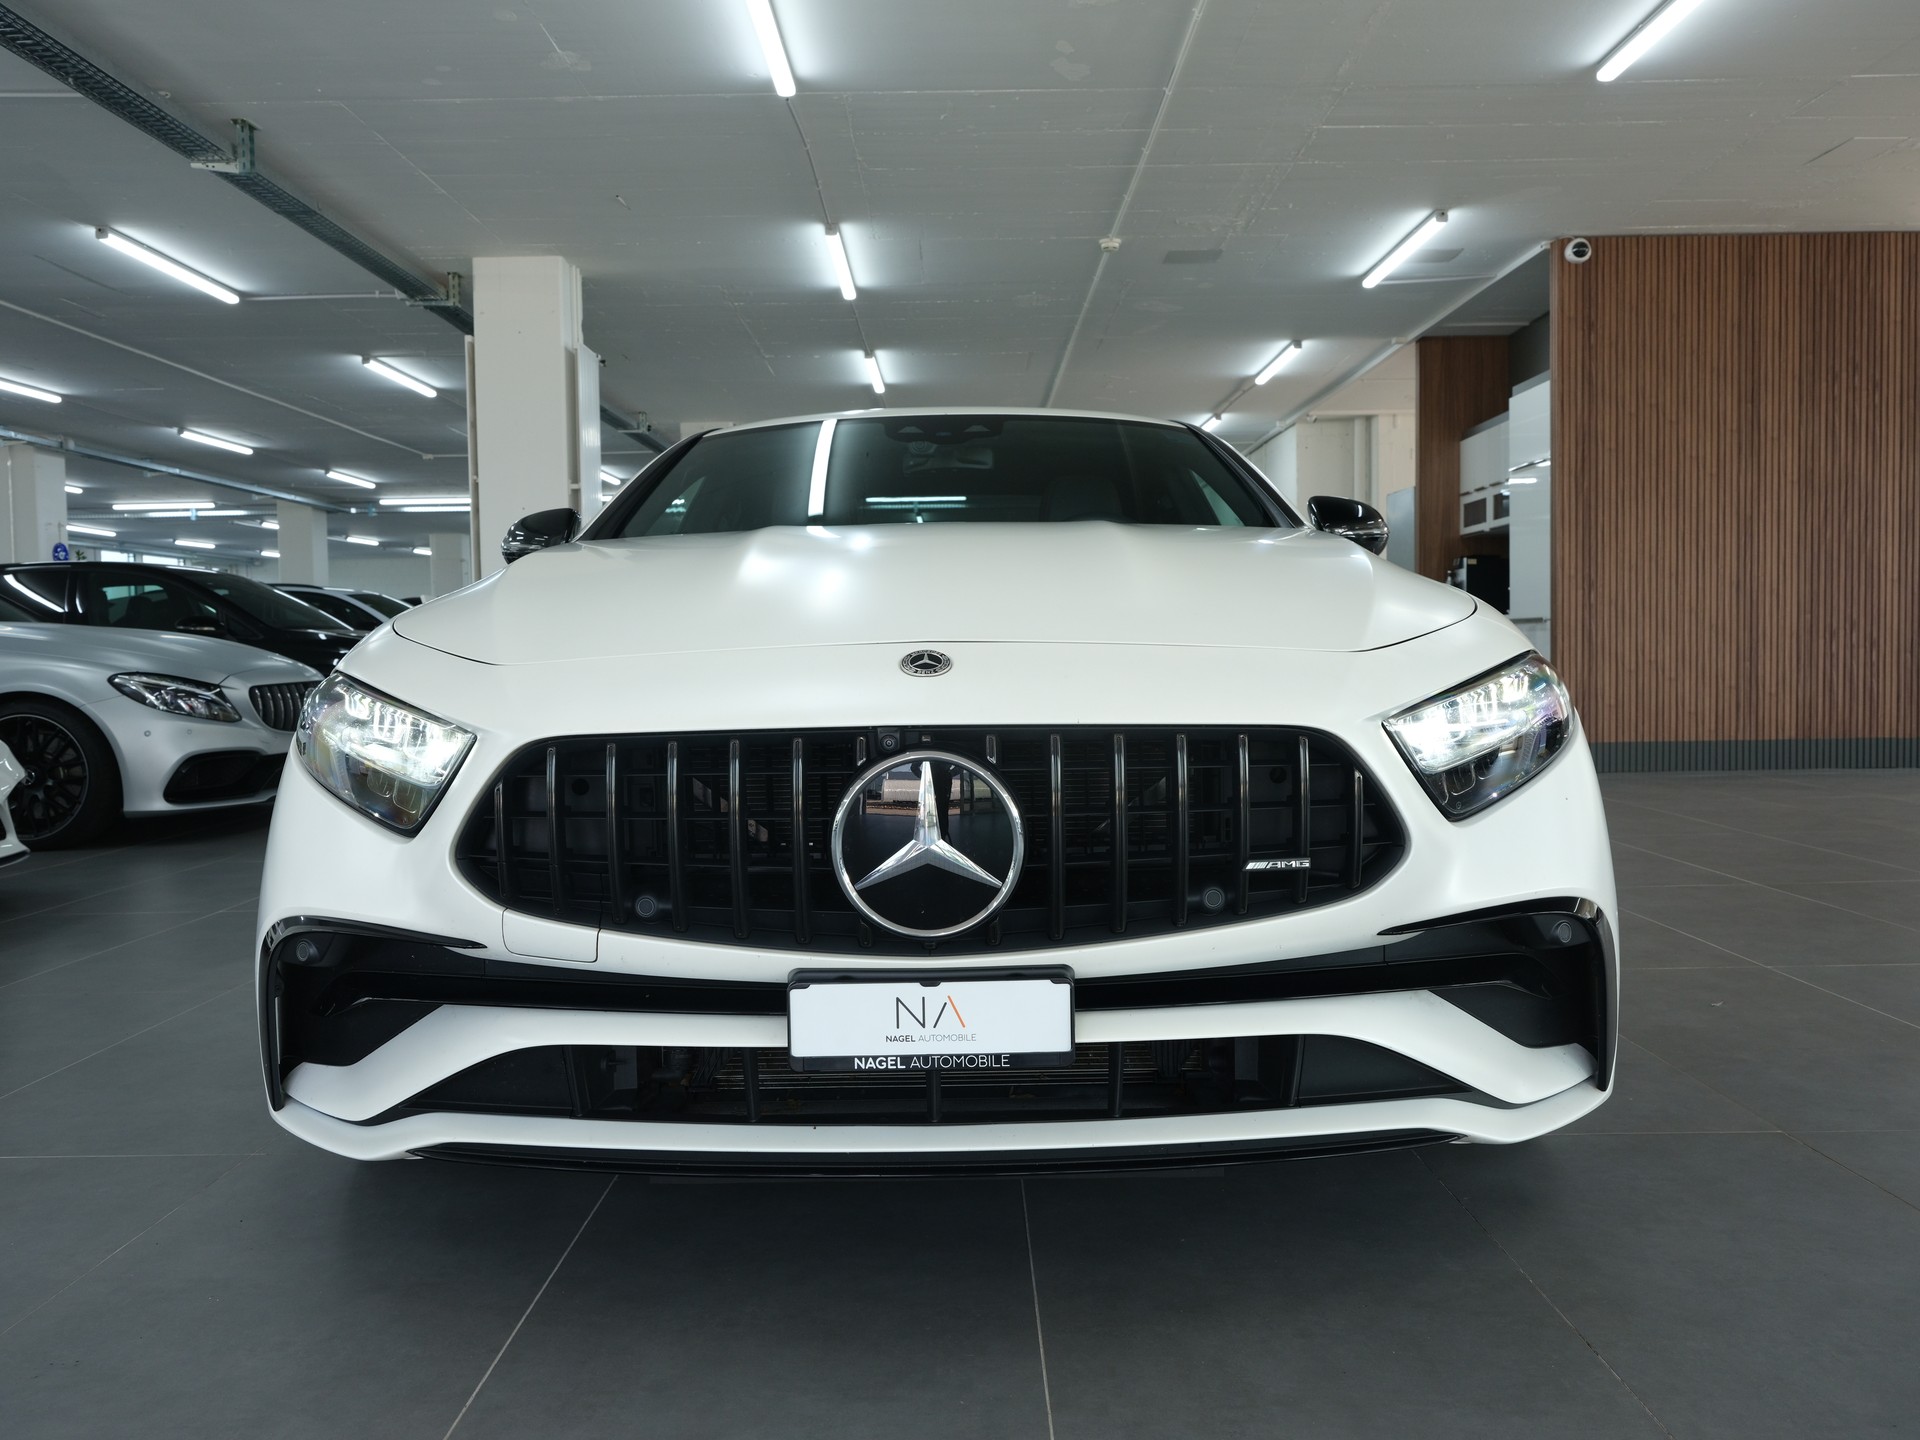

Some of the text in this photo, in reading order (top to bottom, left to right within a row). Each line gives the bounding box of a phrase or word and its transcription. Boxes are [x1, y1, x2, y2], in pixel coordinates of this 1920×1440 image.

[1266, 860, 1310, 869] AMG
[885, 1033, 977, 1043] NAGEL AUTOMOBILE
[854, 1054, 1010, 1070] NAGEL AUTOMOBILE
